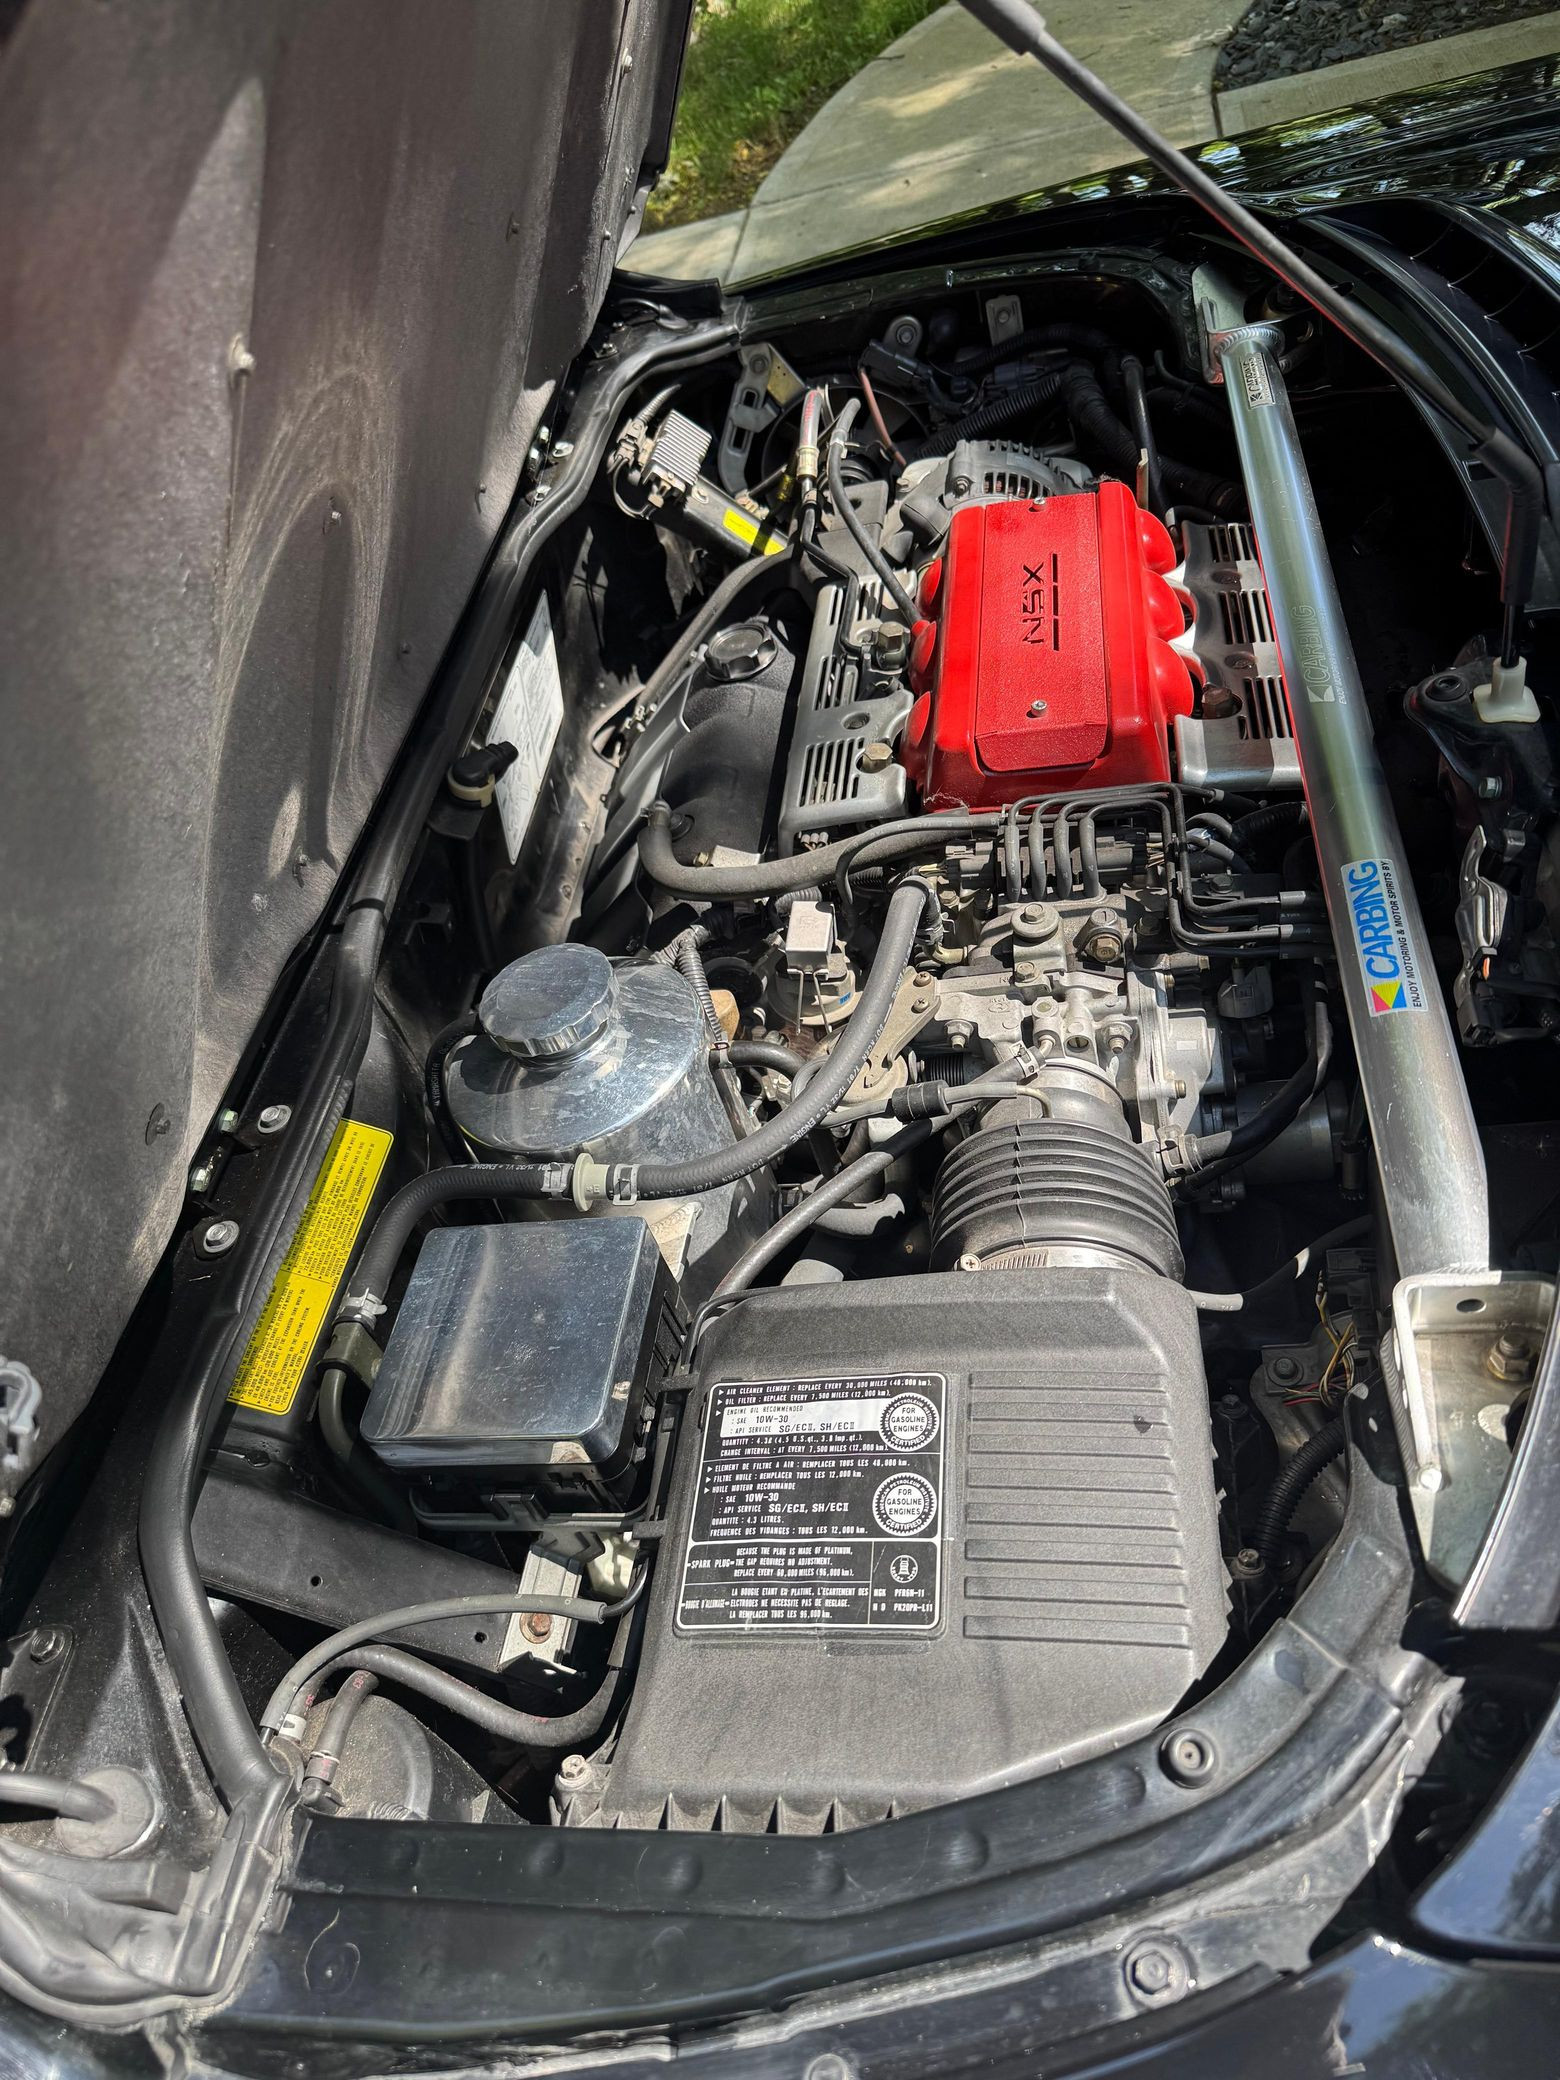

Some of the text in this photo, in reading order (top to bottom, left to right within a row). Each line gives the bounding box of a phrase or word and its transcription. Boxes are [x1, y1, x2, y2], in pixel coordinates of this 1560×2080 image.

[1022, 562, 1045, 645] NSX
[1290, 604, 1331, 684] CARBING
[1347, 861, 1400, 980] CARBING
[1380, 860, 1422, 1007] ENJOY MOTORING & MOTOR SPIRITS BY
[789, 1117, 817, 1144] ENGINE
[797, 1383, 820, 1391] REPLACE
[737, 1396, 756, 1404] FILTER
[755, 1414, 789, 1423] 10W-30
[891, 1415, 925, 1423] GASOLINE
[890, 1434, 925, 1445] CERTIFIED
[744, 1447, 770, 1455] INTERVAL
[787, 1445, 805, 1453] EVERY
[829, 1444, 847, 1452] MILES
[783, 1460, 794, 1468] AIR
[713, 1474, 732, 1482] FILTRE
[814, 1470, 825, 1478] LES
[744, 1492, 779, 1502] 10W-30
[886, 1497, 922, 1506] GASOLINE
[736, 1504, 761, 1513] SERVICE
[888, 1507, 920, 1515] ENGINES
[885, 1518, 922, 1530] CERTIFIED
[744, 1527, 756, 1535] DES
[797, 1526, 813, 1534] TOUS
[816, 1526, 827, 1534] LES
[772, 1547, 786, 1555] PLUG
[786, 1609, 797, 1618] LES
